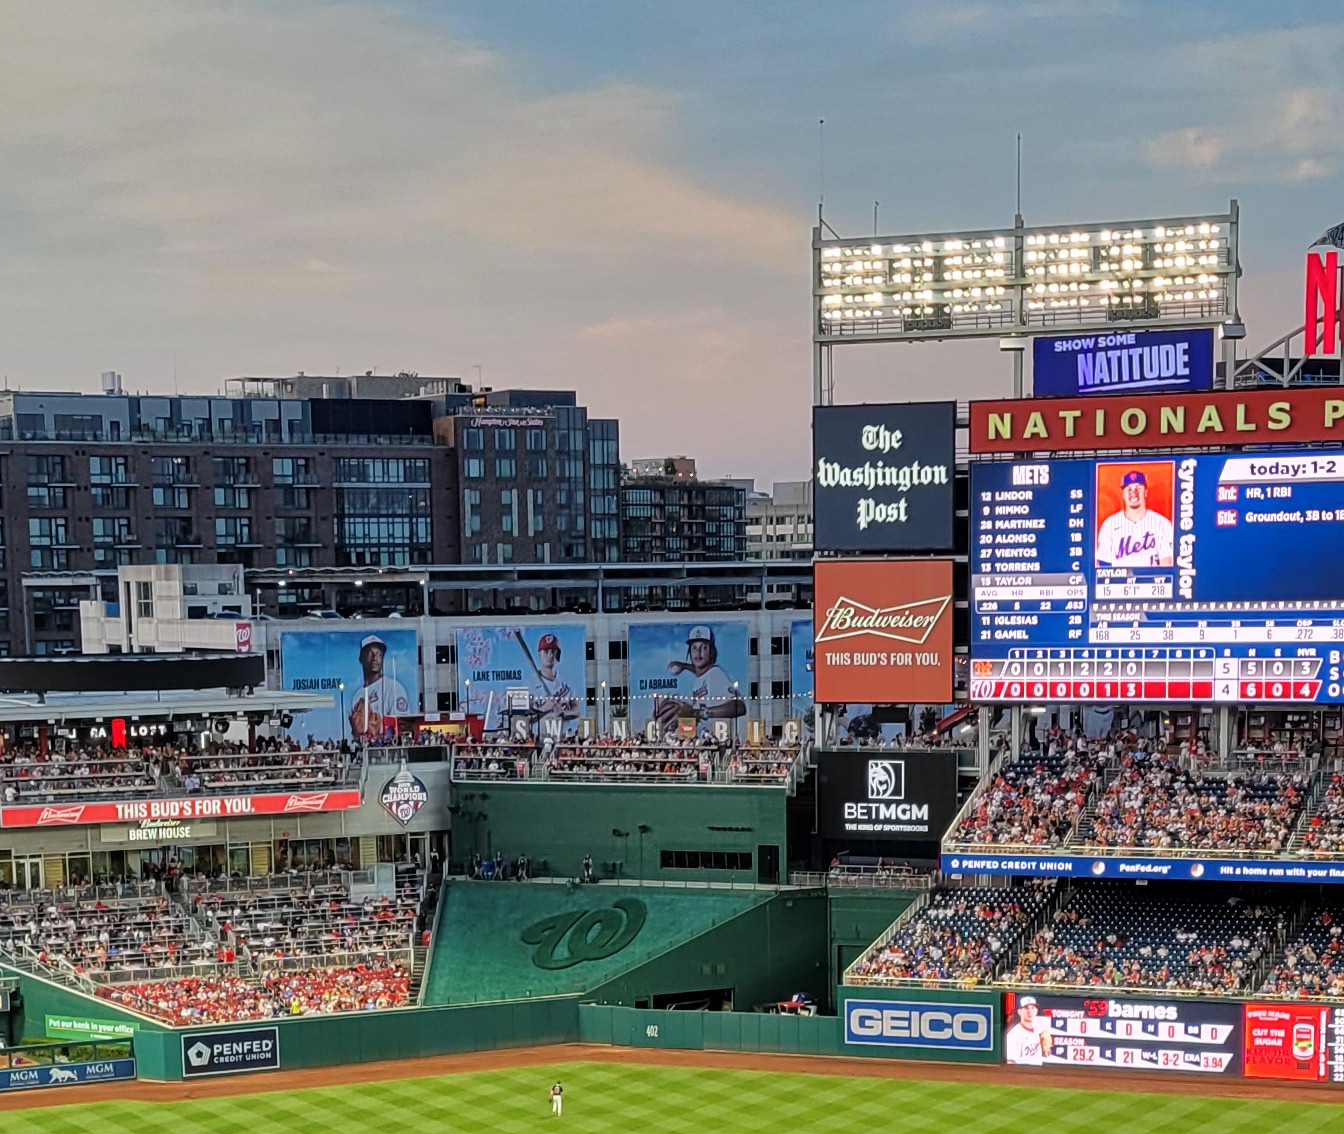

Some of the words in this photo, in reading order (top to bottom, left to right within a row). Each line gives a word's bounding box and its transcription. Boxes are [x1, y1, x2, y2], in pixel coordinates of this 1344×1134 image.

[1054, 337, 1093, 352] SHOW
[1098, 334, 1136, 348] SOME
[1077, 343, 1190, 384] NATITUDE
[988, 402, 1292, 440] NATIONALS
[861, 425, 903, 454] The
[817, 457, 948, 492] Washington
[1012, 465, 1050, 485] METS
[1250, 461, 1306, 477] today:
[1311, 460, 1337, 473] 1-2
[995, 491, 1033, 501] LINDOR
[1178, 459, 1197, 531] tyrone
[857, 498, 908, 531] Post
[995, 505, 1029, 515] NIMMO
[1245, 510, 1304, 523] Groundout,
[1305, 511, 1319, 521] 3B
[1321, 510, 1333, 521] to
[995, 519, 1046, 529] MARTINEZ
[995, 533, 1036, 543] ALONSO
[995, 548, 1038, 558] VIENTOS
[995, 562, 1040, 572] TORRENS
[1176, 534, 1197, 599] taylor
[995, 576, 1032, 585] TAYLOR
[826, 605, 936, 630] Budweiser
[995, 615, 1038, 625] IGLESIAS
[995, 630, 1029, 639] GAMEL
[825, 652, 851, 666] THIS
[854, 652, 888, 666] BUD'S
[891, 652, 913, 666] FOR
[915, 652, 942, 667] YOU.
[472, 670, 490, 682] LANE
[491, 670, 522, 681] THOMAS
[293, 678, 320, 691] JOSIAH
[321, 677, 342, 690] GRAY
[639, 679, 648, 690] CJ
[648, 678, 678, 690] ABRAMS
[131, 725, 166, 737] LOFT
[389, 785, 420, 794] WORLD
[115, 803, 148, 820] THIS
[150, 801, 194, 817] BUD'S
[196, 800, 222, 816] FOR
[224, 798, 256, 815] YOU.
[844, 803, 929, 820] BETMGM
[129, 827, 158, 841] BREW
[159, 825, 191, 840] HOUSE
[962, 859, 999, 871] PENFED
[1001, 860, 1038, 871] CREDIT
[1039, 861, 1072, 872] UNION
[1108, 1000, 1178, 1020] barnes
[646, 1024, 659, 1038] 402
[849, 1007, 988, 1041] GEICO
[213, 1040, 272, 1055] PENFED
[1054, 1036, 1085, 1046] SEASON
[213, 1054, 243, 1063] CREDIT
[245, 1052, 272, 1061] UNION
[10, 1070, 38, 1082] MGM
[85, 1063, 114, 1075] MGM
